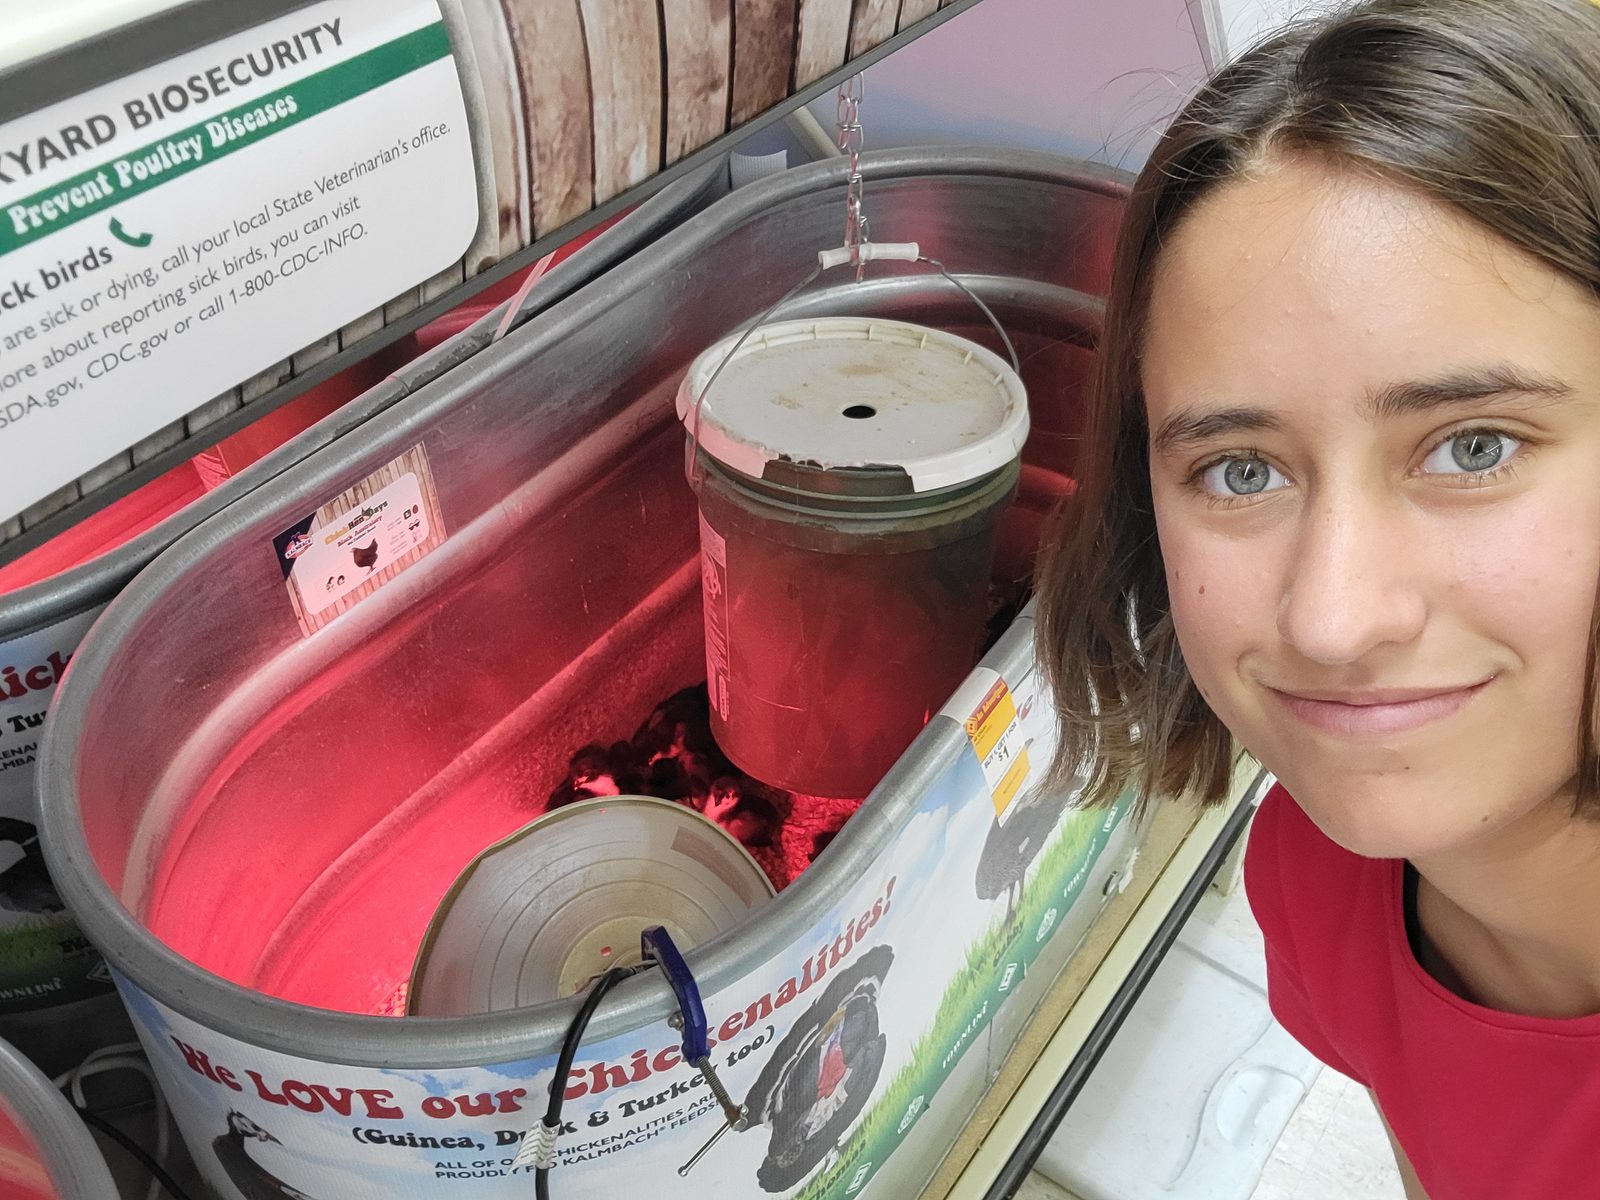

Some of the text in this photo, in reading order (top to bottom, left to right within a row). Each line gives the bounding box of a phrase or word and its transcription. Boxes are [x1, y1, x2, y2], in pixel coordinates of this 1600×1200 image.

[123, 17, 343, 130] BIOSECURITY
[7, 95, 297, 234] Prevent Poultry Diseases
[0, 246, 112, 314] ck birds
[3, 122, 451, 350] are sick or dying, call your local State Veterinarian's office.
[42, 331, 98, 369] about
[102, 288, 187, 338] reporting
[189, 267, 221, 295] sick
[223, 247, 268, 276] birds,
[270, 228, 299, 257] you
[304, 214, 329, 235] can
[332, 196, 361, 220] visit
[86, 329, 169, 378] CDC.gov
[174, 316, 193, 334] or
[199, 295, 225, 321] call
[228, 222, 368, 304] 1-800-CDC-INFO.
[170, 1034, 242, 1092] We
[244, 1070, 404, 1119] LOVE
[421, 1088, 527, 1119] our
[352, 1127, 485, 1150] (Guinea,
[494, 1121, 578, 1146] Dk
[587, 1110, 609, 1127] &
[726, 1024, 775, 1067] too)
[434, 1161, 467, 1169] ALL
[472, 1159, 495, 1168] OF
